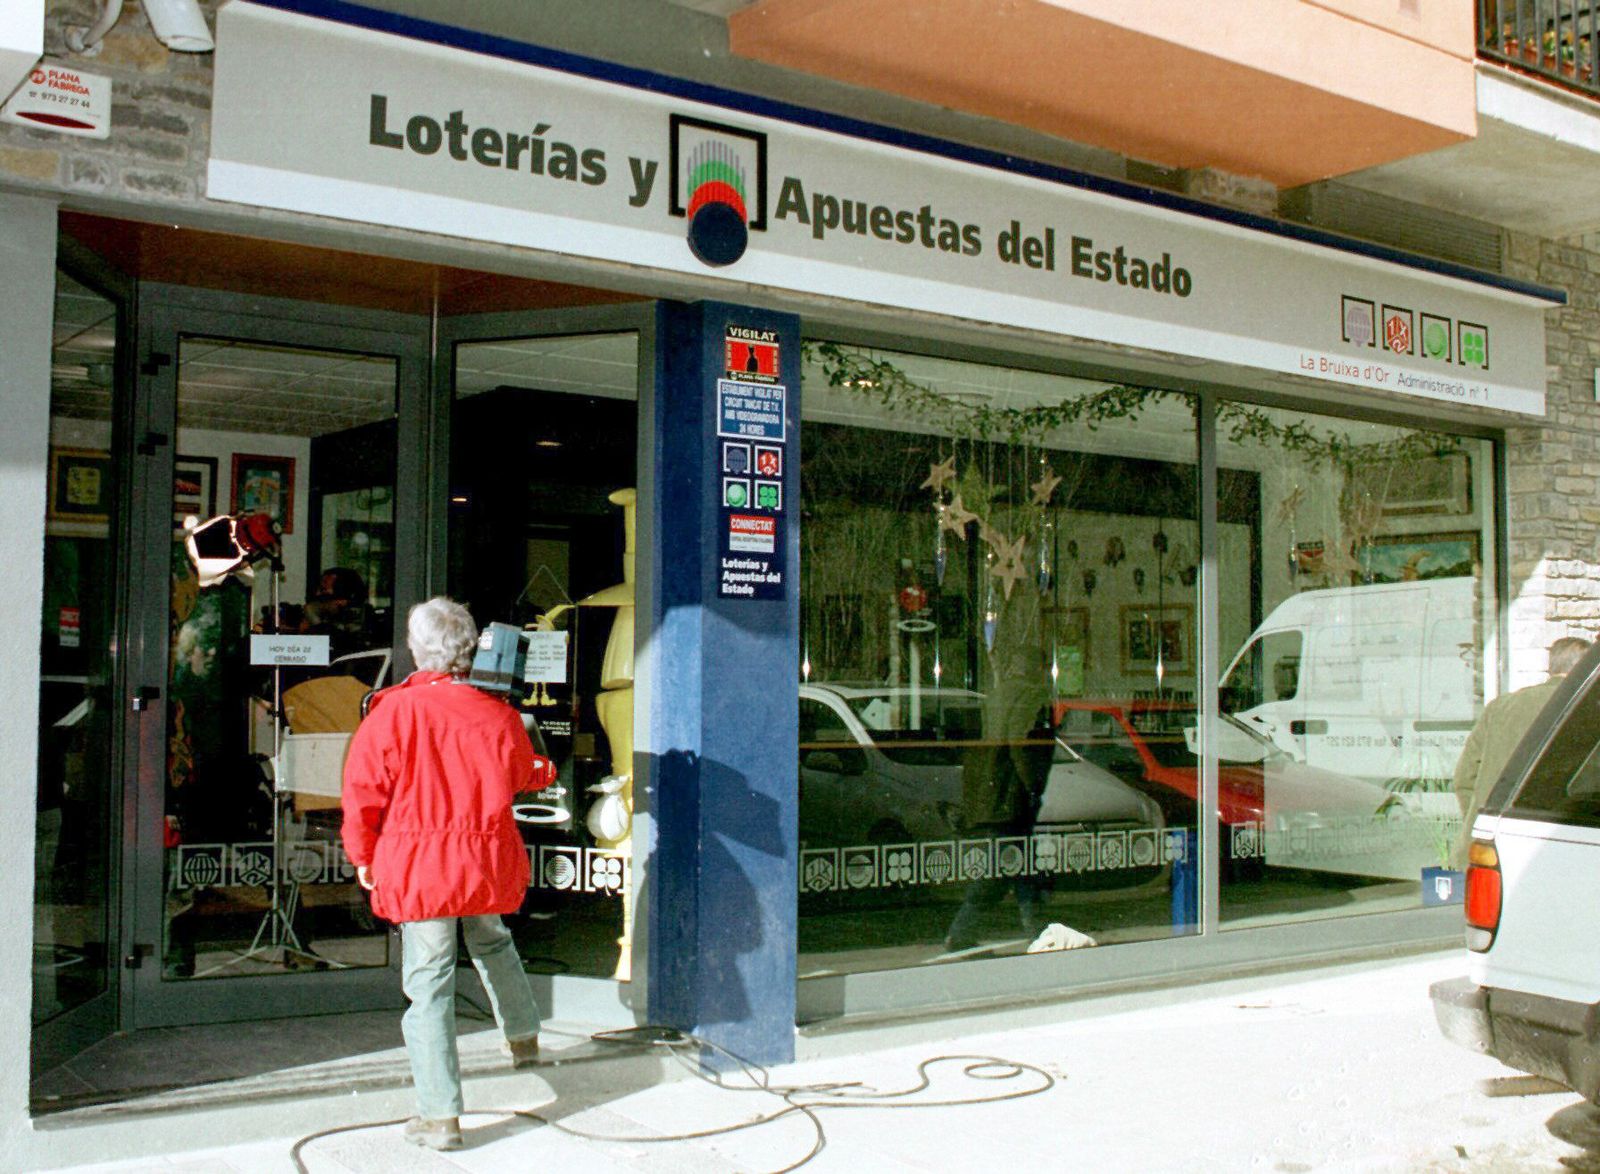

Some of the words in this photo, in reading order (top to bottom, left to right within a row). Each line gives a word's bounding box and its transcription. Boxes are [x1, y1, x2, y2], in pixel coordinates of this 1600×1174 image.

[48, 70, 80, 84] PLANA
[370, 94, 607, 186] Loterías
[628, 156, 659, 208] y
[774, 175, 982, 257] Apuestas
[998, 220, 1055, 271] del
[1071, 235, 1192, 298] Estado
[729, 327, 776, 341] VIGILAT
[1300, 353, 1315, 370] La
[1320, 357, 1359, 378] Bruixa
[1365, 365, 1389, 382] d'Or
[1398, 373, 1465, 397] Administració
[730, 518, 773, 531] CONNECTAT
[722, 558, 760, 570] Loterías
[762, 562, 768, 572] y
[722, 571, 765, 584] Apuestas
[767, 572, 780, 584] del
[722, 583, 754, 595] Estado
